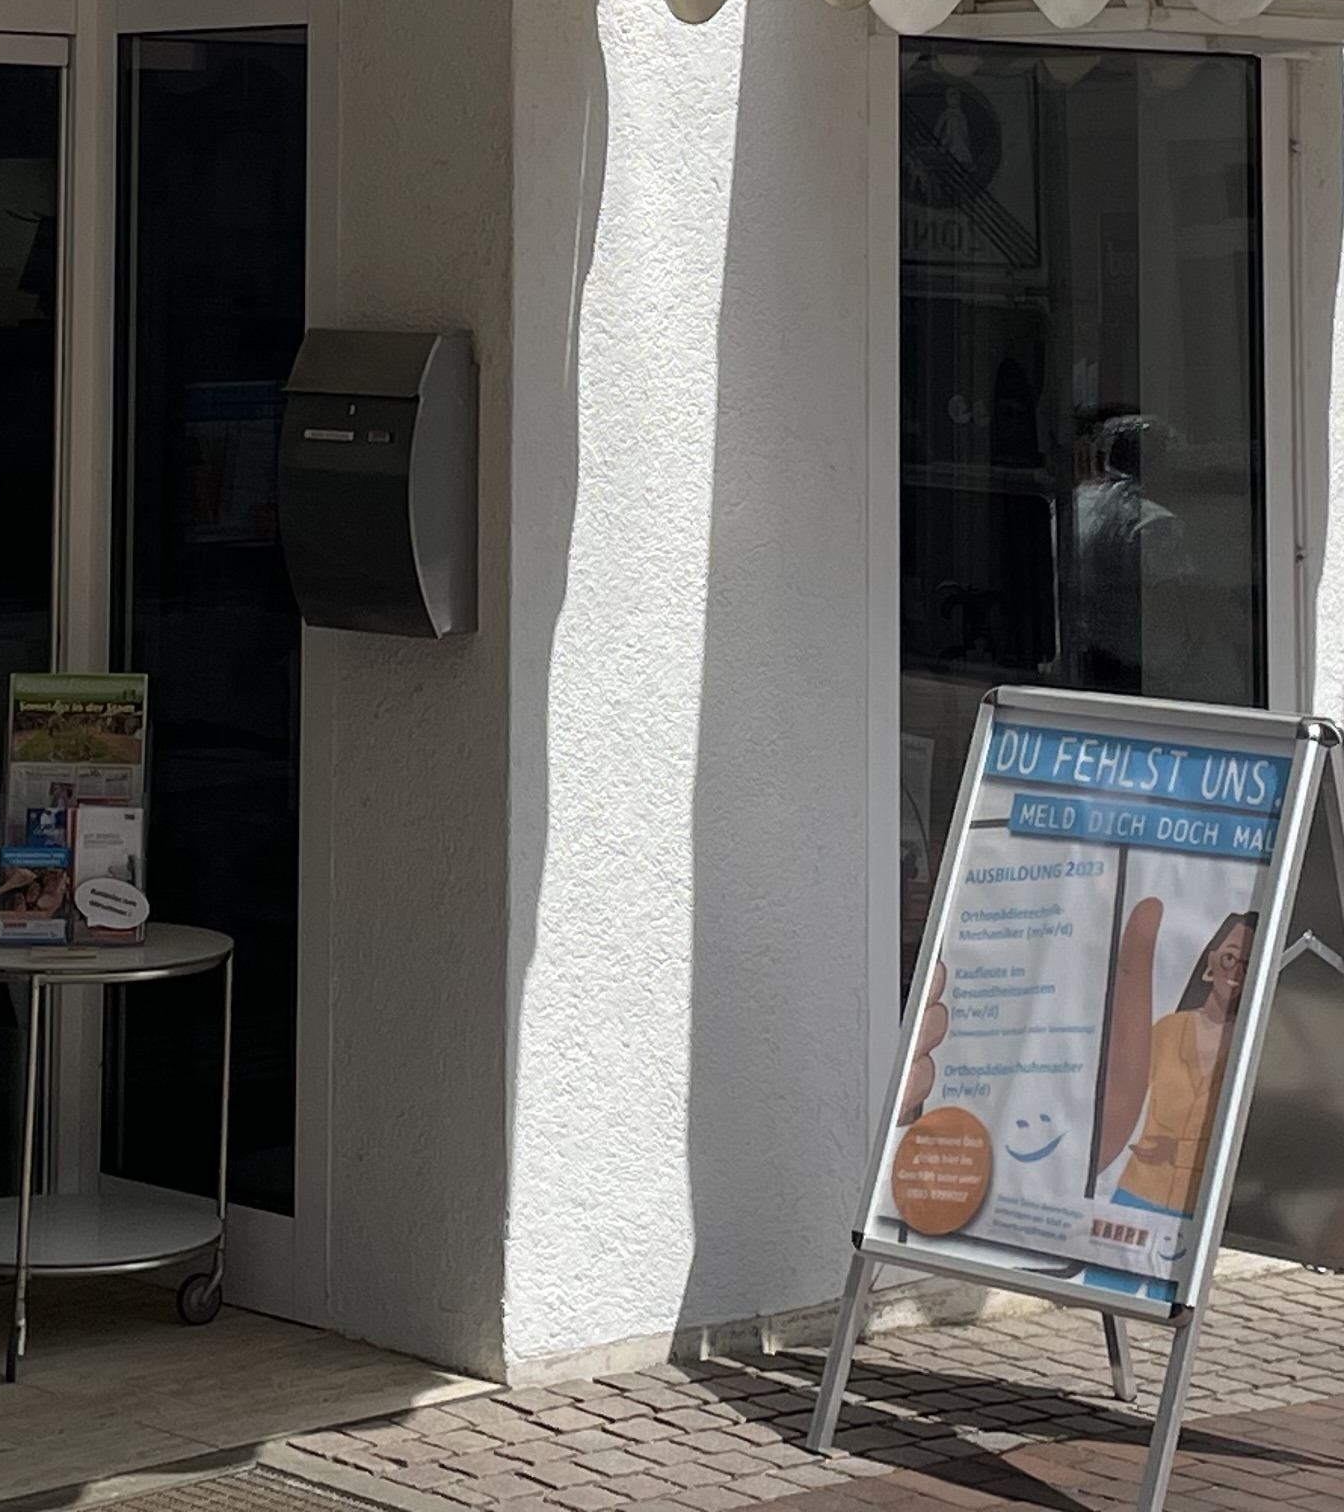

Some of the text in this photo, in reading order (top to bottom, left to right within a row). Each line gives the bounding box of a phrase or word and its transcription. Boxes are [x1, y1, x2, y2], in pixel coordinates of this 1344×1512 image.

[995, 729, 1043, 775] DU
[1053, 736, 1189, 792] FEHLST
[1019, 803, 1075, 829] MELD
[1088, 810, 1146, 836] DICH
[1156, 817, 1219, 845] DOCH
[965, 860, 1105, 884] AUSBILDUNG 2023
